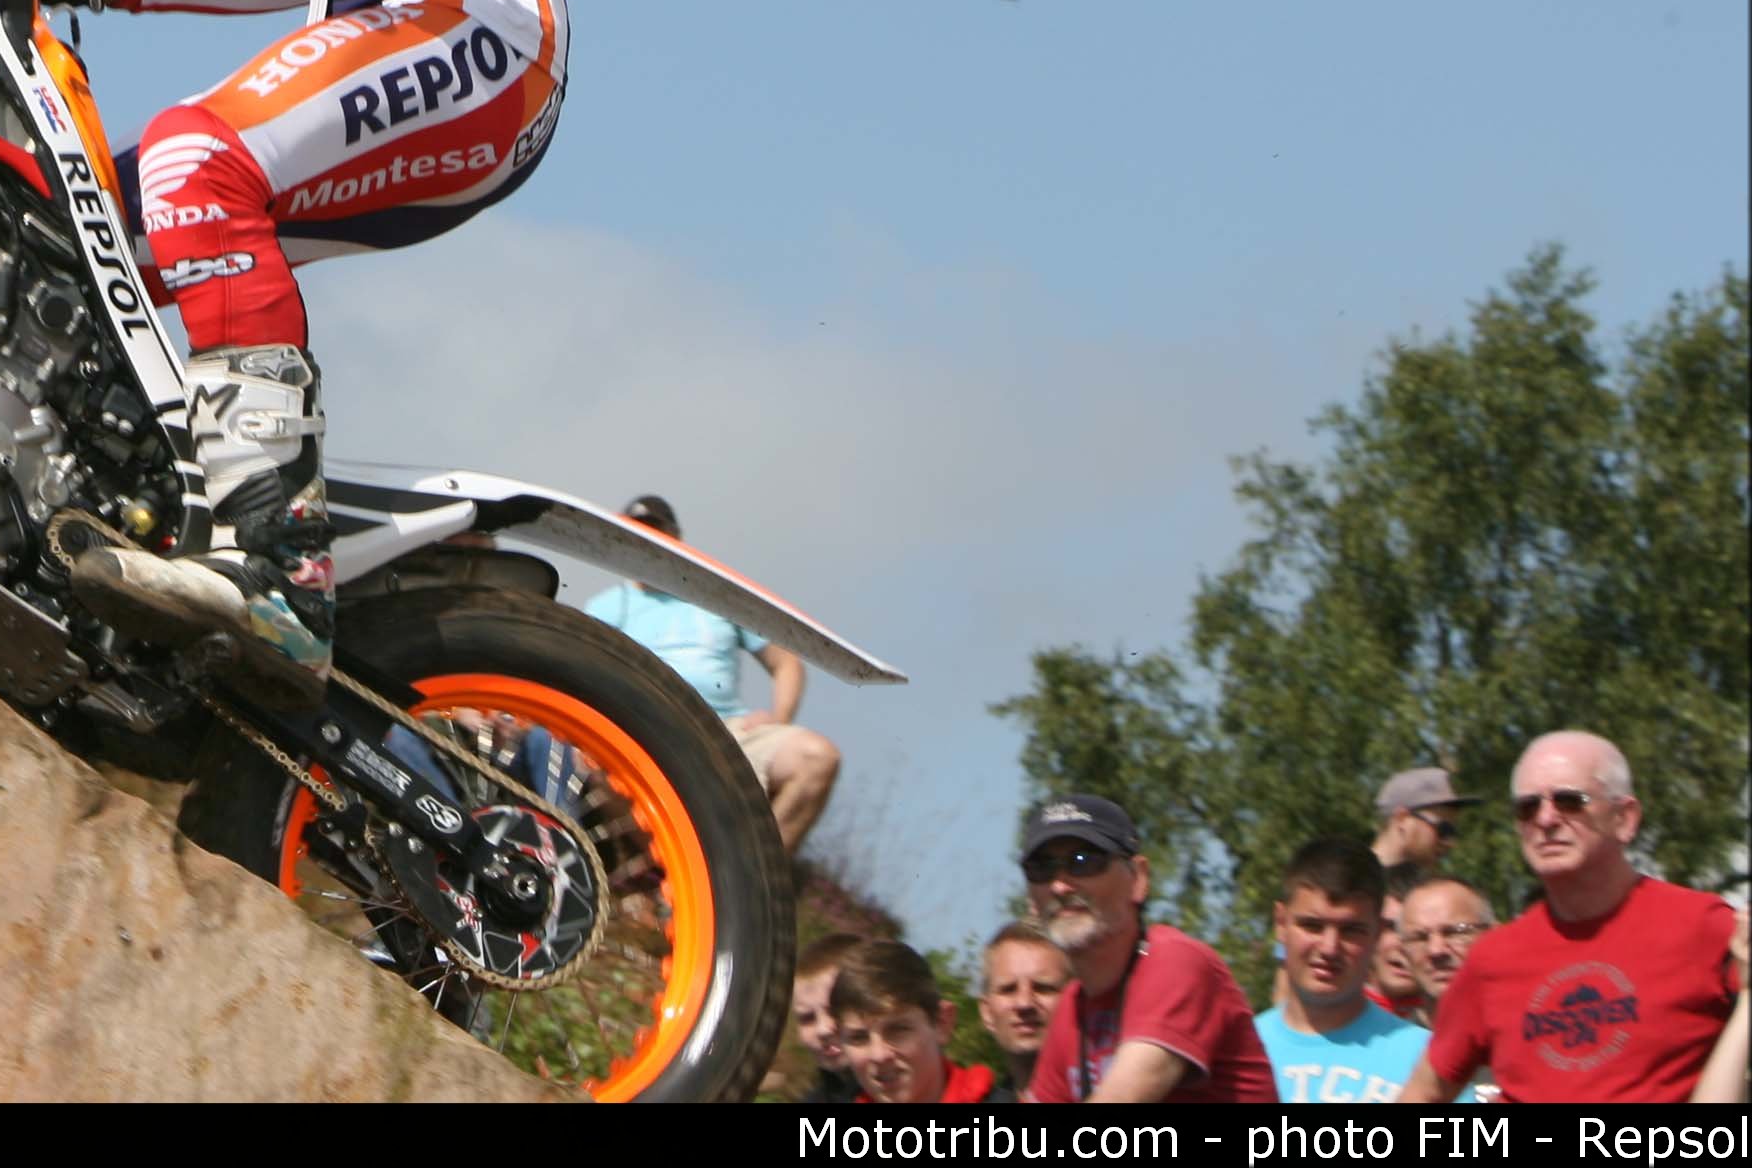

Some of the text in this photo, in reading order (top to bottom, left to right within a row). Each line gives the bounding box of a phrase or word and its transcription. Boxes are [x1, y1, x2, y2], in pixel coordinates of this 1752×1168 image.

[238, 4, 425, 97] HONDA
[287, 142, 498, 215] Montesa
[58, 152, 151, 339] REPSOL
